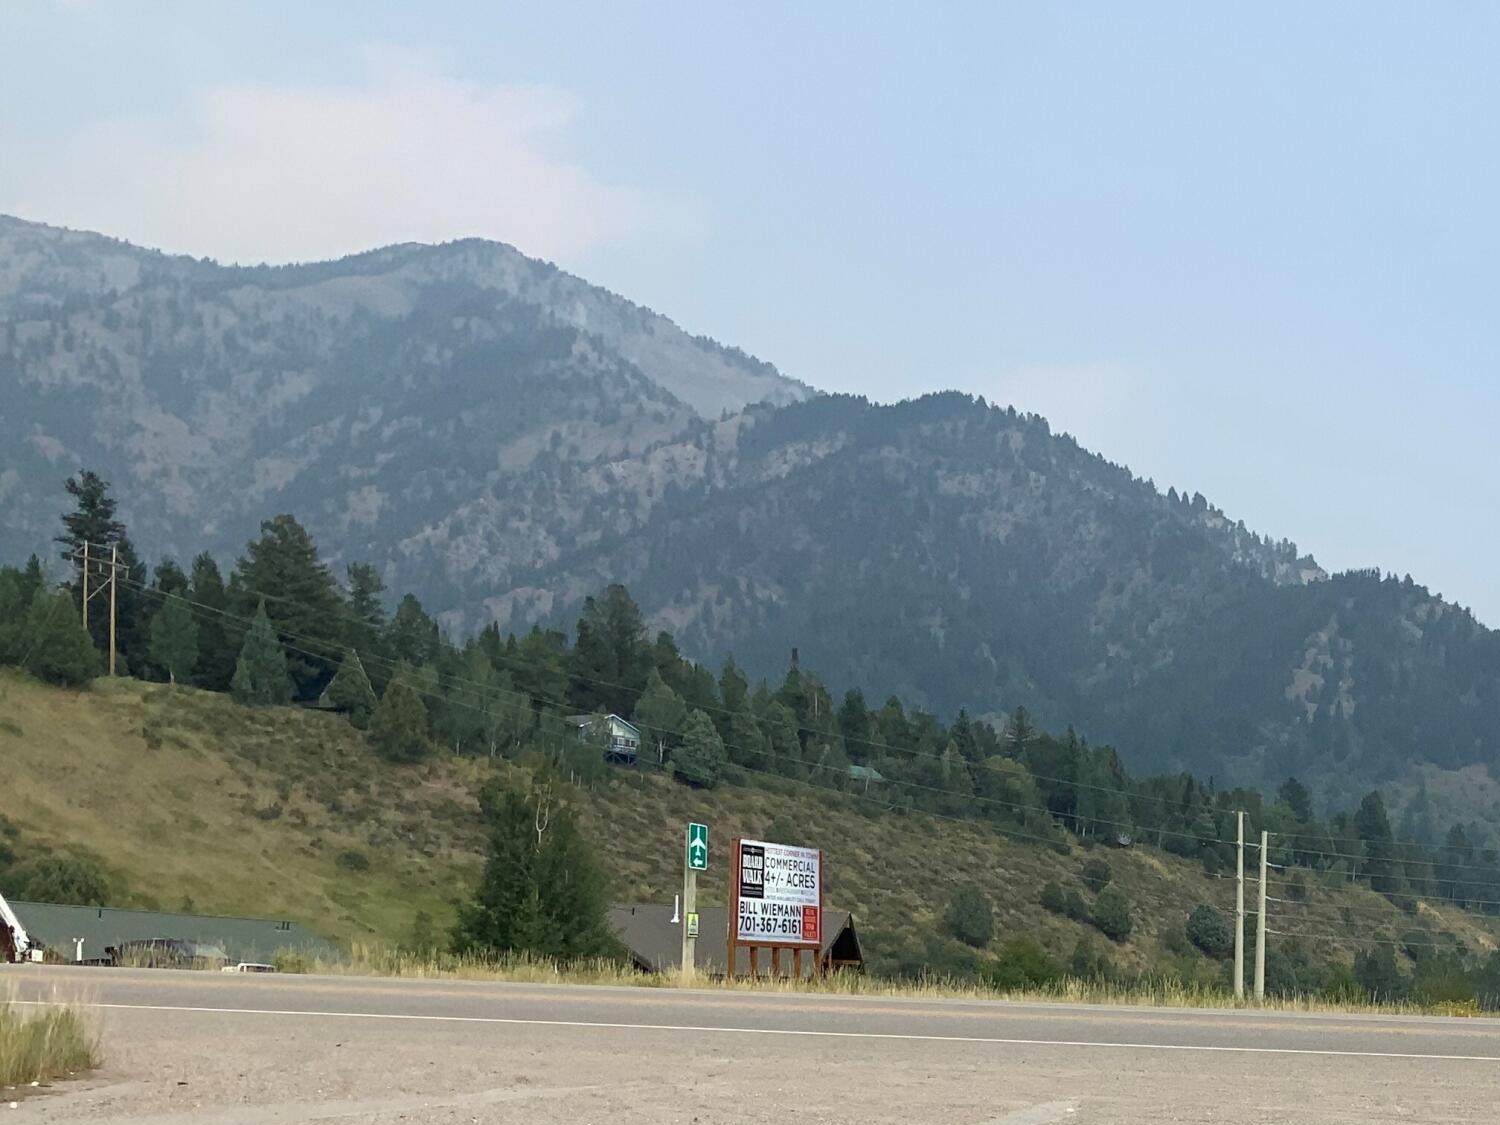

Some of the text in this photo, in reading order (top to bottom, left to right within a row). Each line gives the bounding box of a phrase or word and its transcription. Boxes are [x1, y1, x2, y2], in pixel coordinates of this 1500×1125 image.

[765, 857, 815, 873] COMMERCIAL
[765, 871, 815, 888] 4+/- ACRES
[740, 901, 757, 914] BILL
[761, 902, 801, 917] WIEMANN
[740, 916, 801, 934] 701-367-6161
